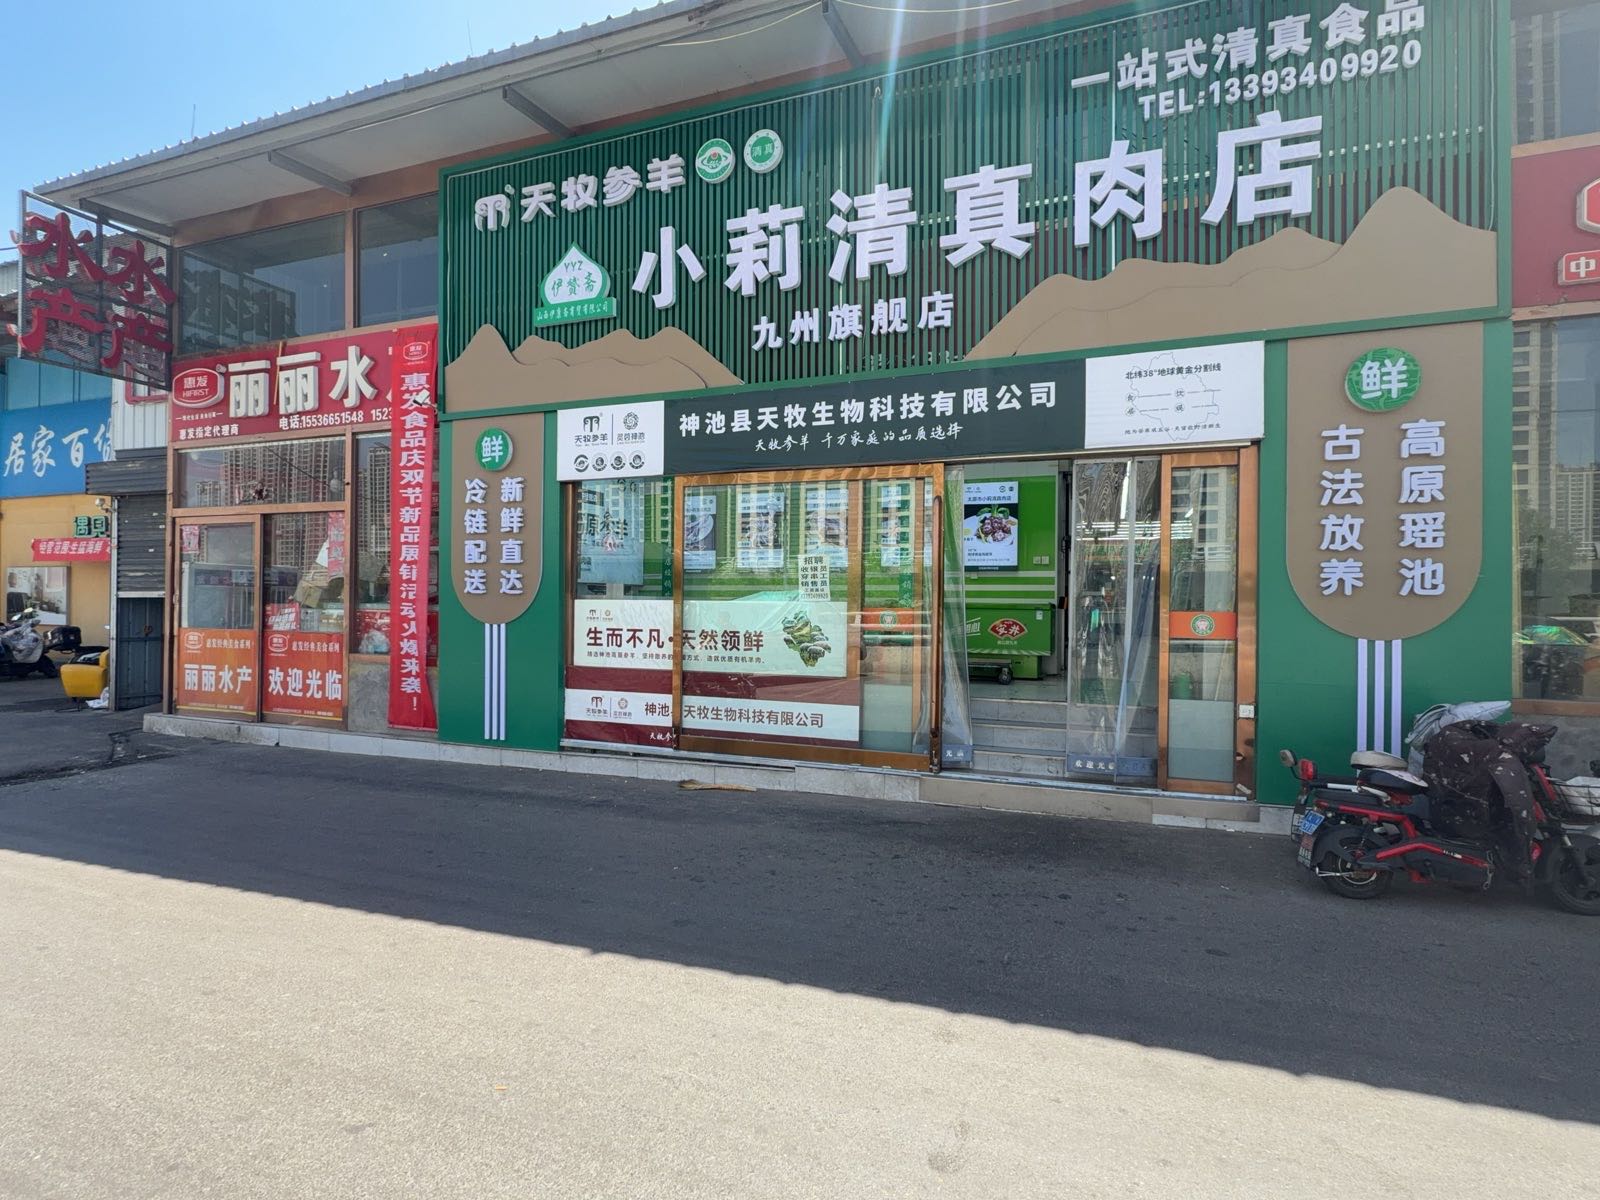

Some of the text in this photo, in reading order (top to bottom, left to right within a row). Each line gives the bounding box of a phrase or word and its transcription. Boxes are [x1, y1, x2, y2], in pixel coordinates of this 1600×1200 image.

[1071, 0, 1425, 91] 一站式清真食品
[1138, 39, 1422, 121] TEL:13393409920
[521, 153, 686, 223] 天牧参羊
[631, 110, 1323, 310] 小莉清真肉店
[751, 291, 954, 351] 九州旗舰店
[184, 375, 208, 389] 惠发
[228, 346, 392, 417] 丽丽水
[1360, 357, 1408, 399] 鲜
[679, 381, 1056, 437] 神池县天牧生物科技有限公司
[821, 421, 964, 449] 千万家庭的品质选择
[481, 435, 503, 463] 鲜
[463, 478, 488, 595] 冷链配送
[499, 476, 524, 595] 新鲜直达
[1320, 424, 1364, 596] 古法放养
[1398, 418, 1445, 597] 高原瑶池
[804, 556, 823, 565] 招聘
[184, 664, 252, 694] 丽丽水产
[268, 667, 342, 701] 欢迎光临
[644, 702, 824, 729] 神池天牧生物科技有限公司
